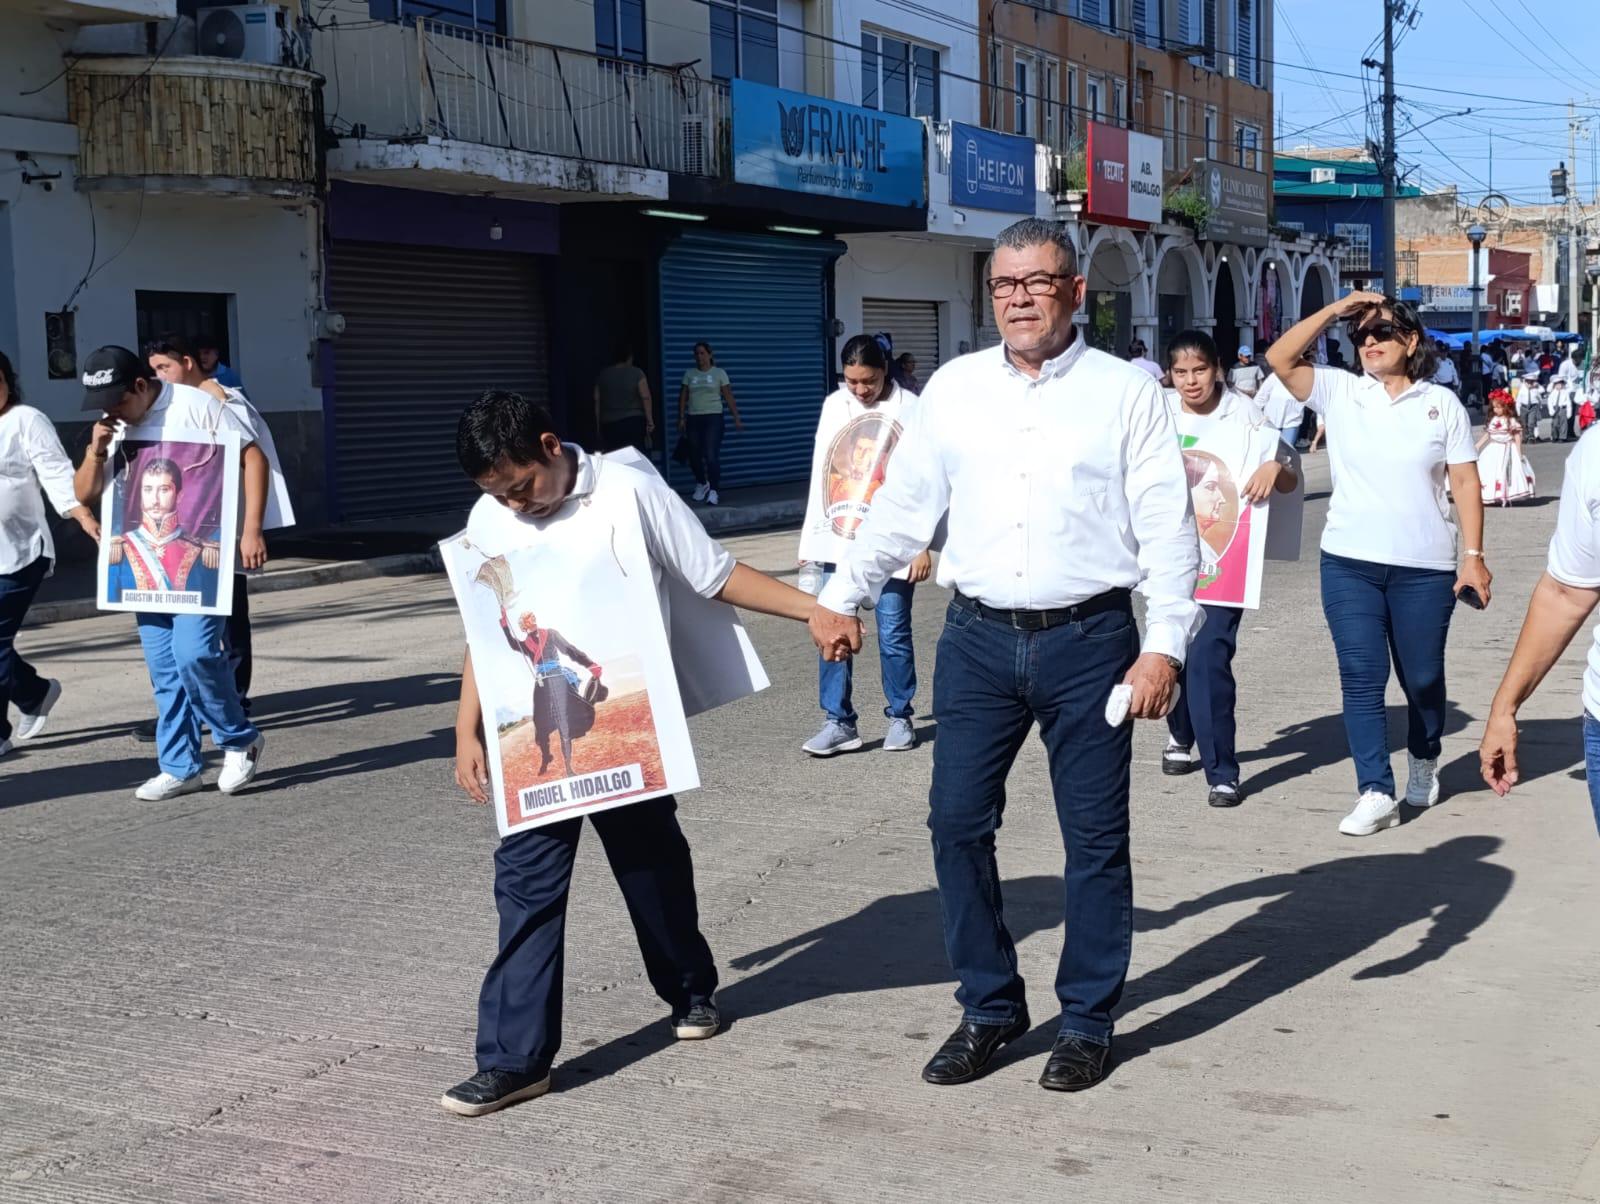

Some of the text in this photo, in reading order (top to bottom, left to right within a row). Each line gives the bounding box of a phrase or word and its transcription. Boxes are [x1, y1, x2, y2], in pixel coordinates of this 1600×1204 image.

[808, 104, 888, 173] FRAICHE
[797, 166, 840, 188] Perfumando
[978, 157, 1024, 186] HEIFON
[1103, 160, 1125, 183] TECATE
[1141, 161, 1152, 176] AB.
[1130, 180, 1161, 197] HIDALGO
[154, 593, 163, 604] DE
[165, 594, 199, 605] ITURBIDE
[524, 770, 632, 811] MIGUEL HIDALGO
